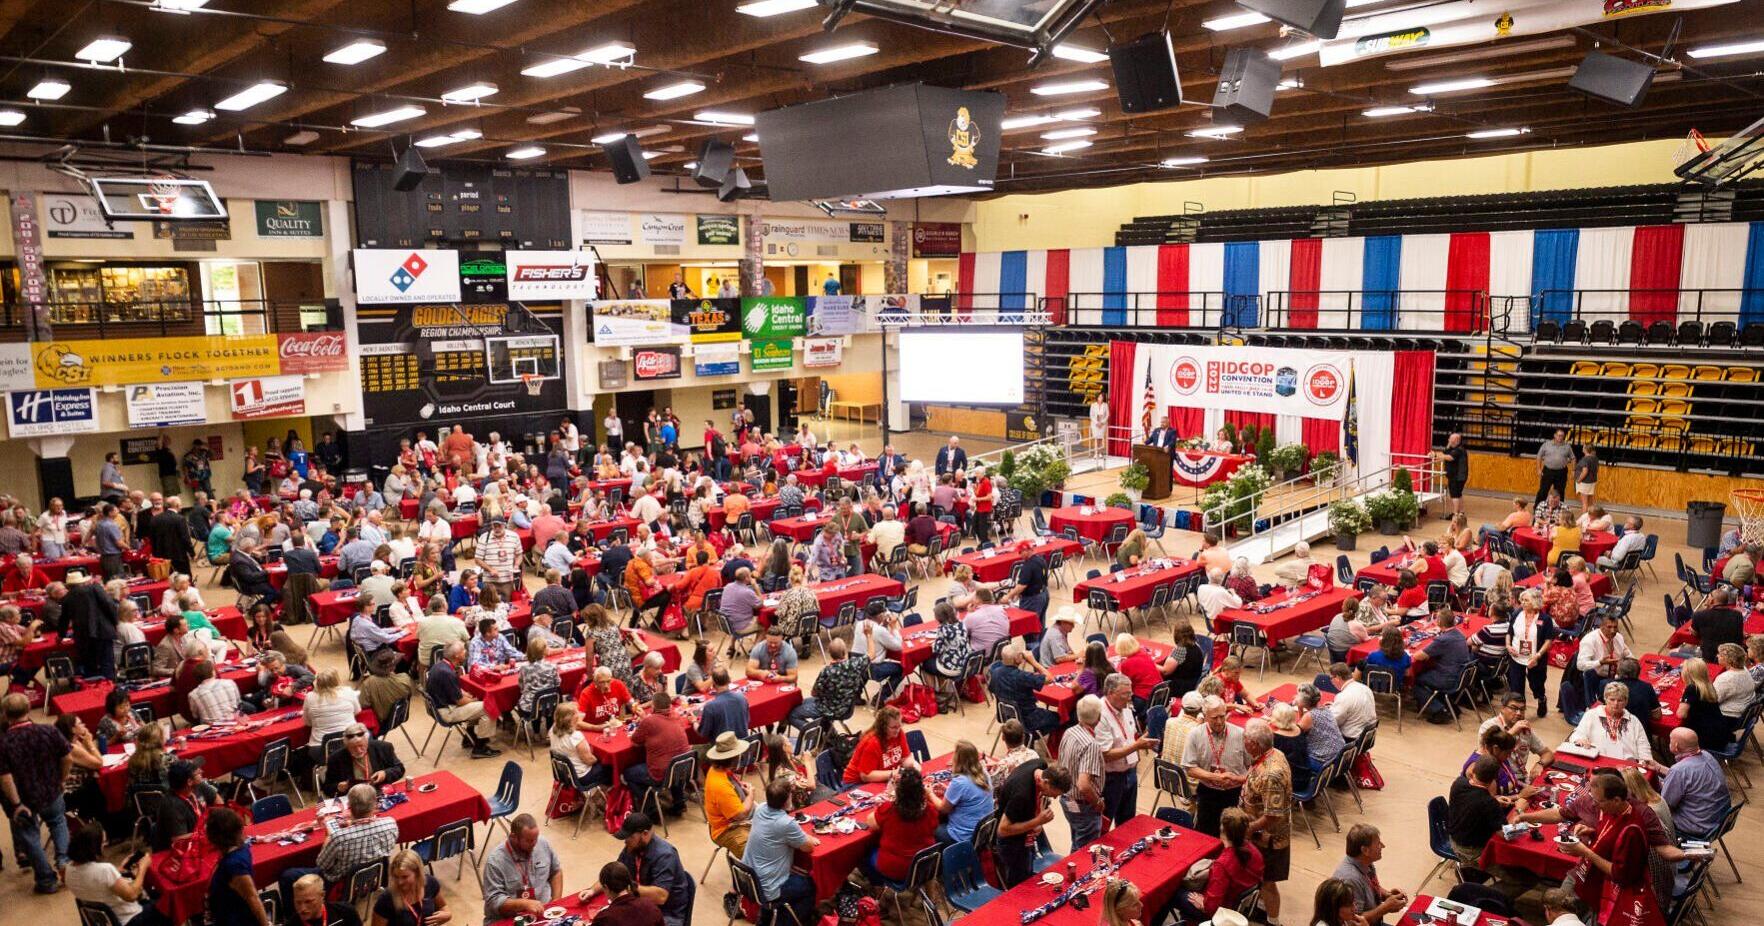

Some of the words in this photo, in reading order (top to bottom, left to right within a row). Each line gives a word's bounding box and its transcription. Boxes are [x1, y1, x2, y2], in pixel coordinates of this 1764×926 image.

[267, 217, 312, 230] QUALITY
[771, 224, 805, 235] rainguard
[772, 304, 795, 314] Idaho
[413, 306, 464, 328] GOLDEN
[467, 304, 509, 325] EAGLES
[689, 312, 725, 325] TEXAS
[772, 313, 803, 324] Central
[420, 328, 448, 338] REGION
[448, 326, 503, 337] CHAMPIONSHIPS
[280, 336, 344, 358] Coca-Cola
[89, 352, 152, 364] WINNERS
[158, 351, 200, 361] FLOCK
[206, 347, 270, 358] TOGETHER
[1221, 361, 1274, 376] IDGOP
[1208, 362, 1218, 393] 2022
[55, 402, 90, 412] Express
[439, 404, 462, 415] Idaho
[463, 400, 492, 413] Central
[494, 400, 516, 410] Court
